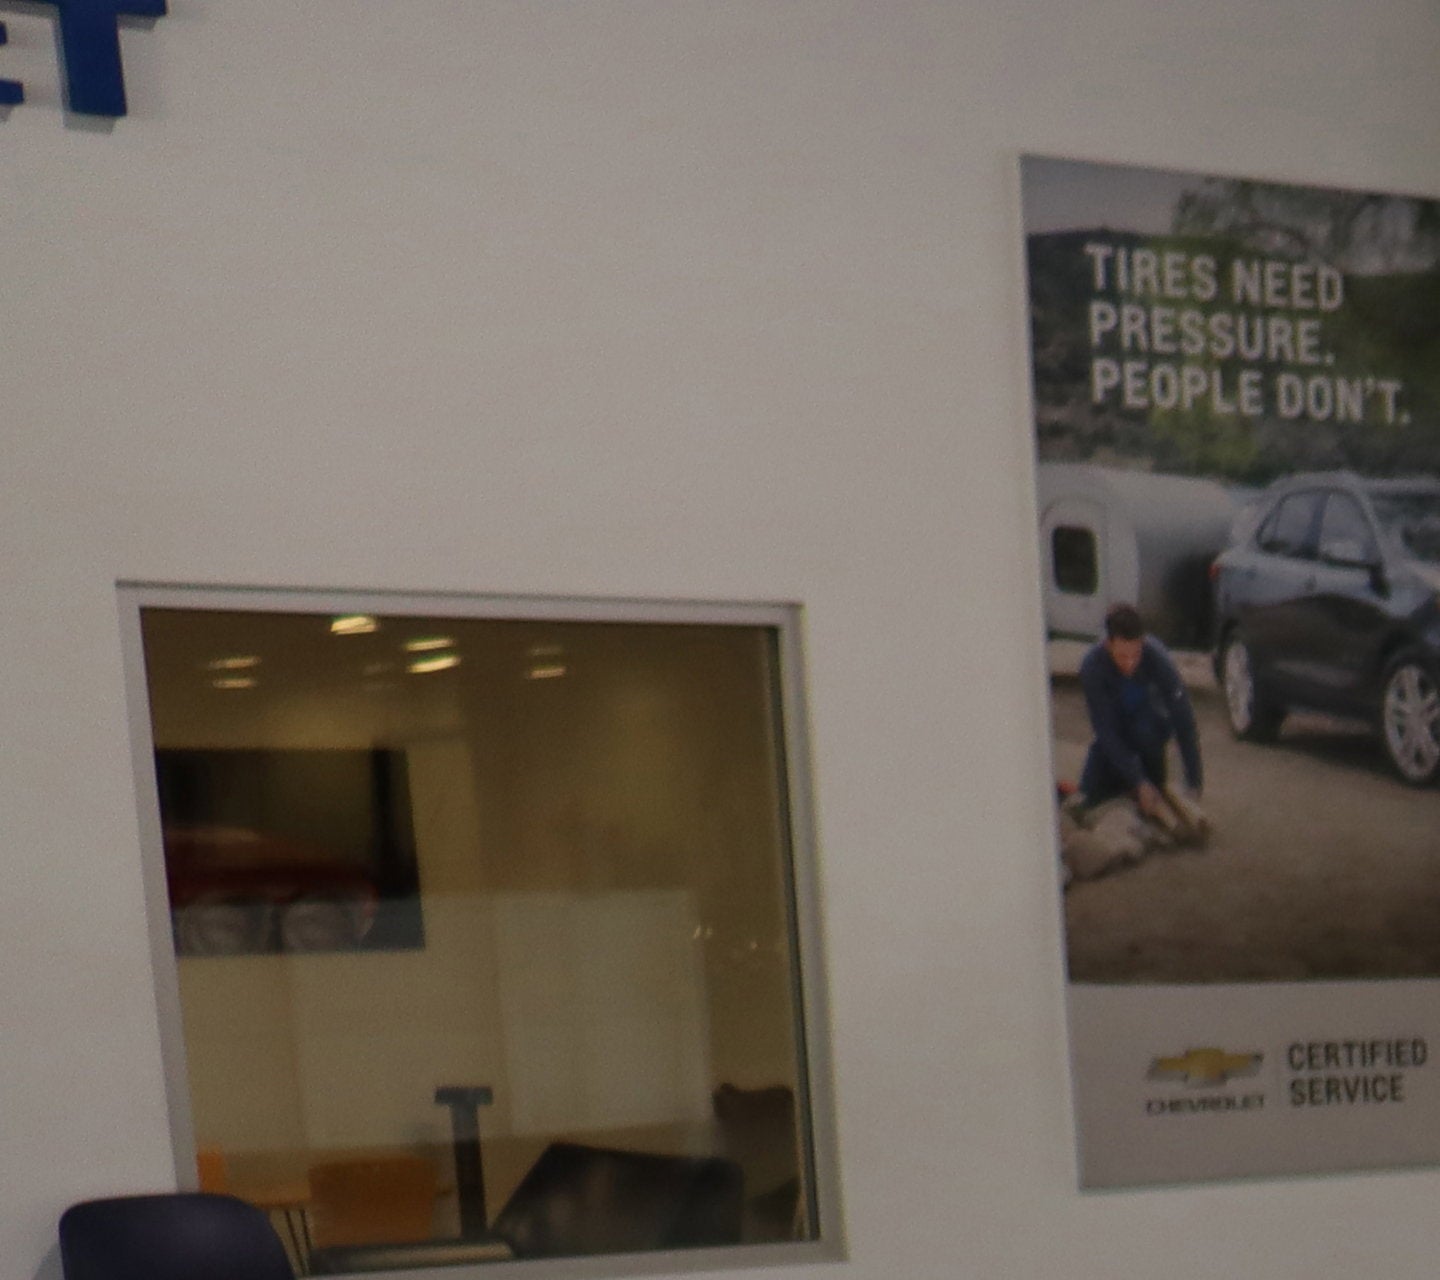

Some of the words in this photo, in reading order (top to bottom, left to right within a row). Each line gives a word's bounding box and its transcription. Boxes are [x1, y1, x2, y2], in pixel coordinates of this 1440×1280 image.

[0, 0, 167, 117] T
[1084, 243, 1218, 301] TIRES
[1232, 260, 1344, 312] NEED
[1088, 302, 1336, 367] PRESSURE.
[1092, 357, 1264, 416] PEOPLE
[1276, 376, 1412, 426] DON'T.
[1288, 1037, 1429, 1072] CERTIFIED
[1289, 1074, 1404, 1107] SERVICE
